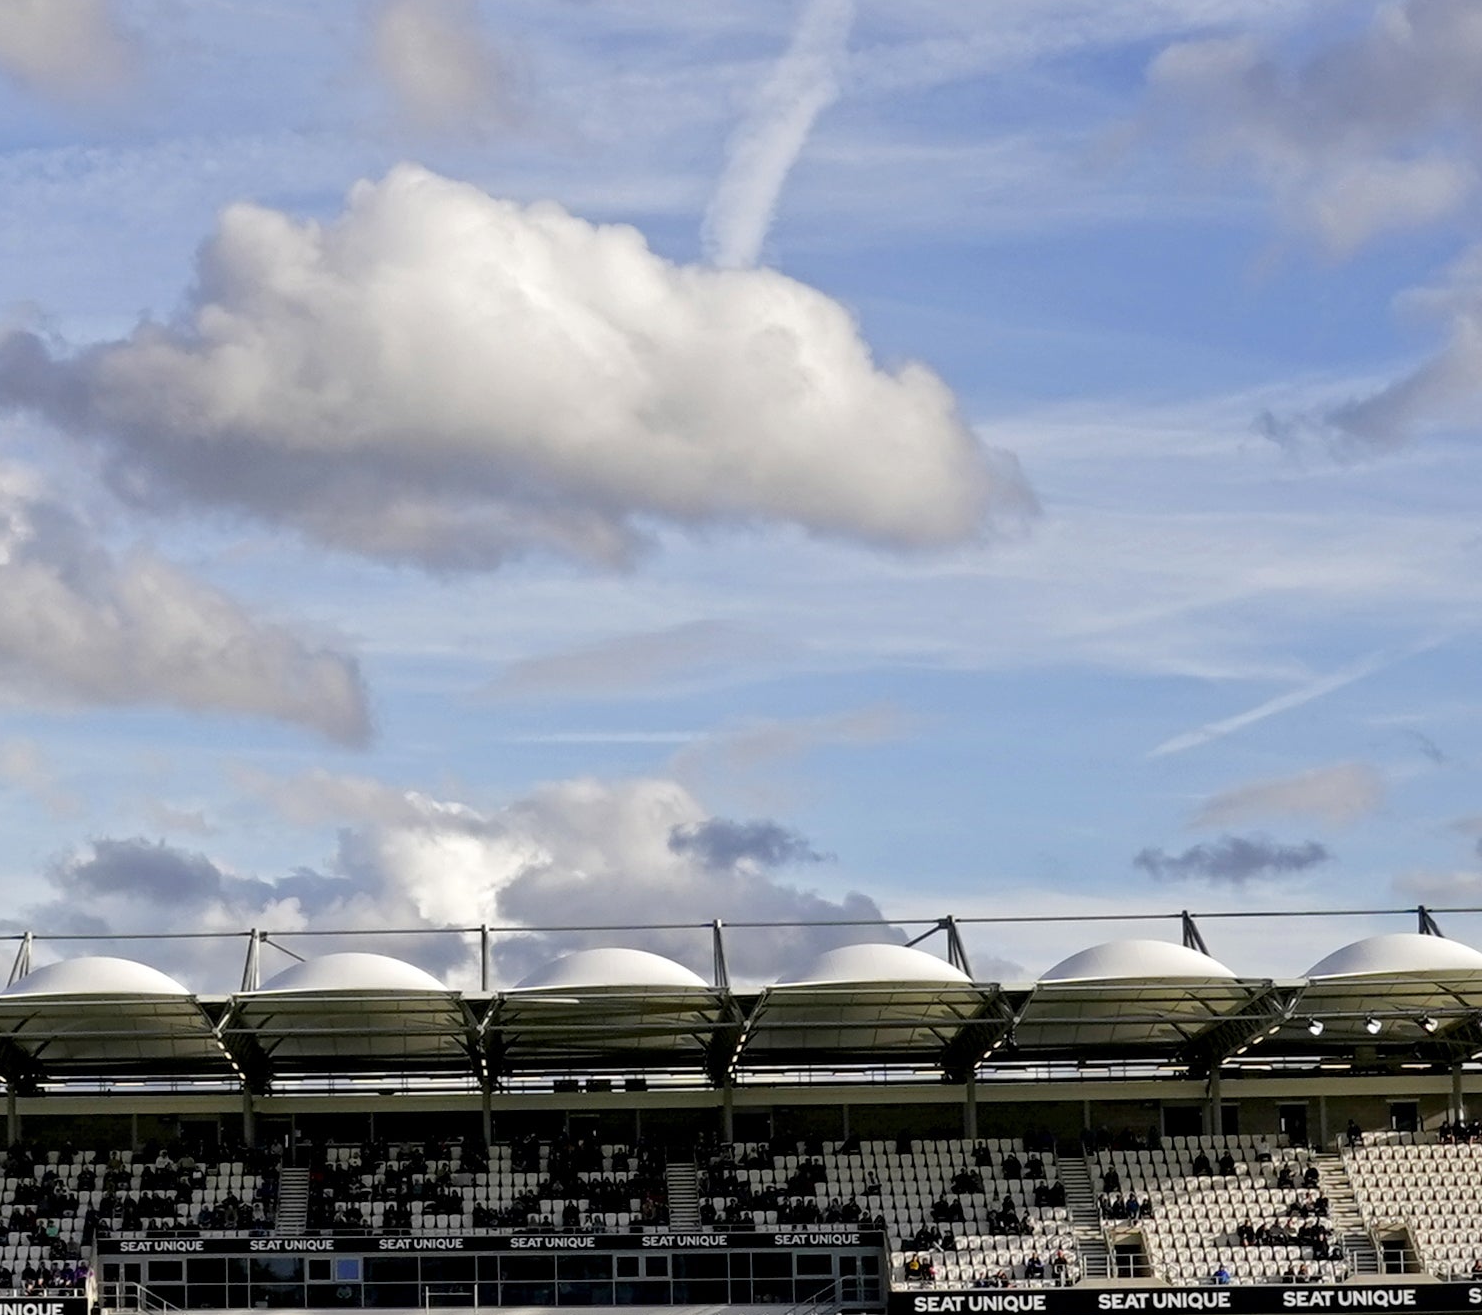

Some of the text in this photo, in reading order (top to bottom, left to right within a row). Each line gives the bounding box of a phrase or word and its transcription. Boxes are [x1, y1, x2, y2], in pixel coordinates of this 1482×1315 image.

[120, 1240, 204, 1252] SEAT UNIQUE
[379, 1238, 463, 1250] SEAT UNIQUE
[642, 1235, 727, 1247] SEAT UNIQUE
[914, 1295, 1046, 1313] SEAT UNIQUE
[1283, 1289, 1416, 1308] SEAT UNIQUE
